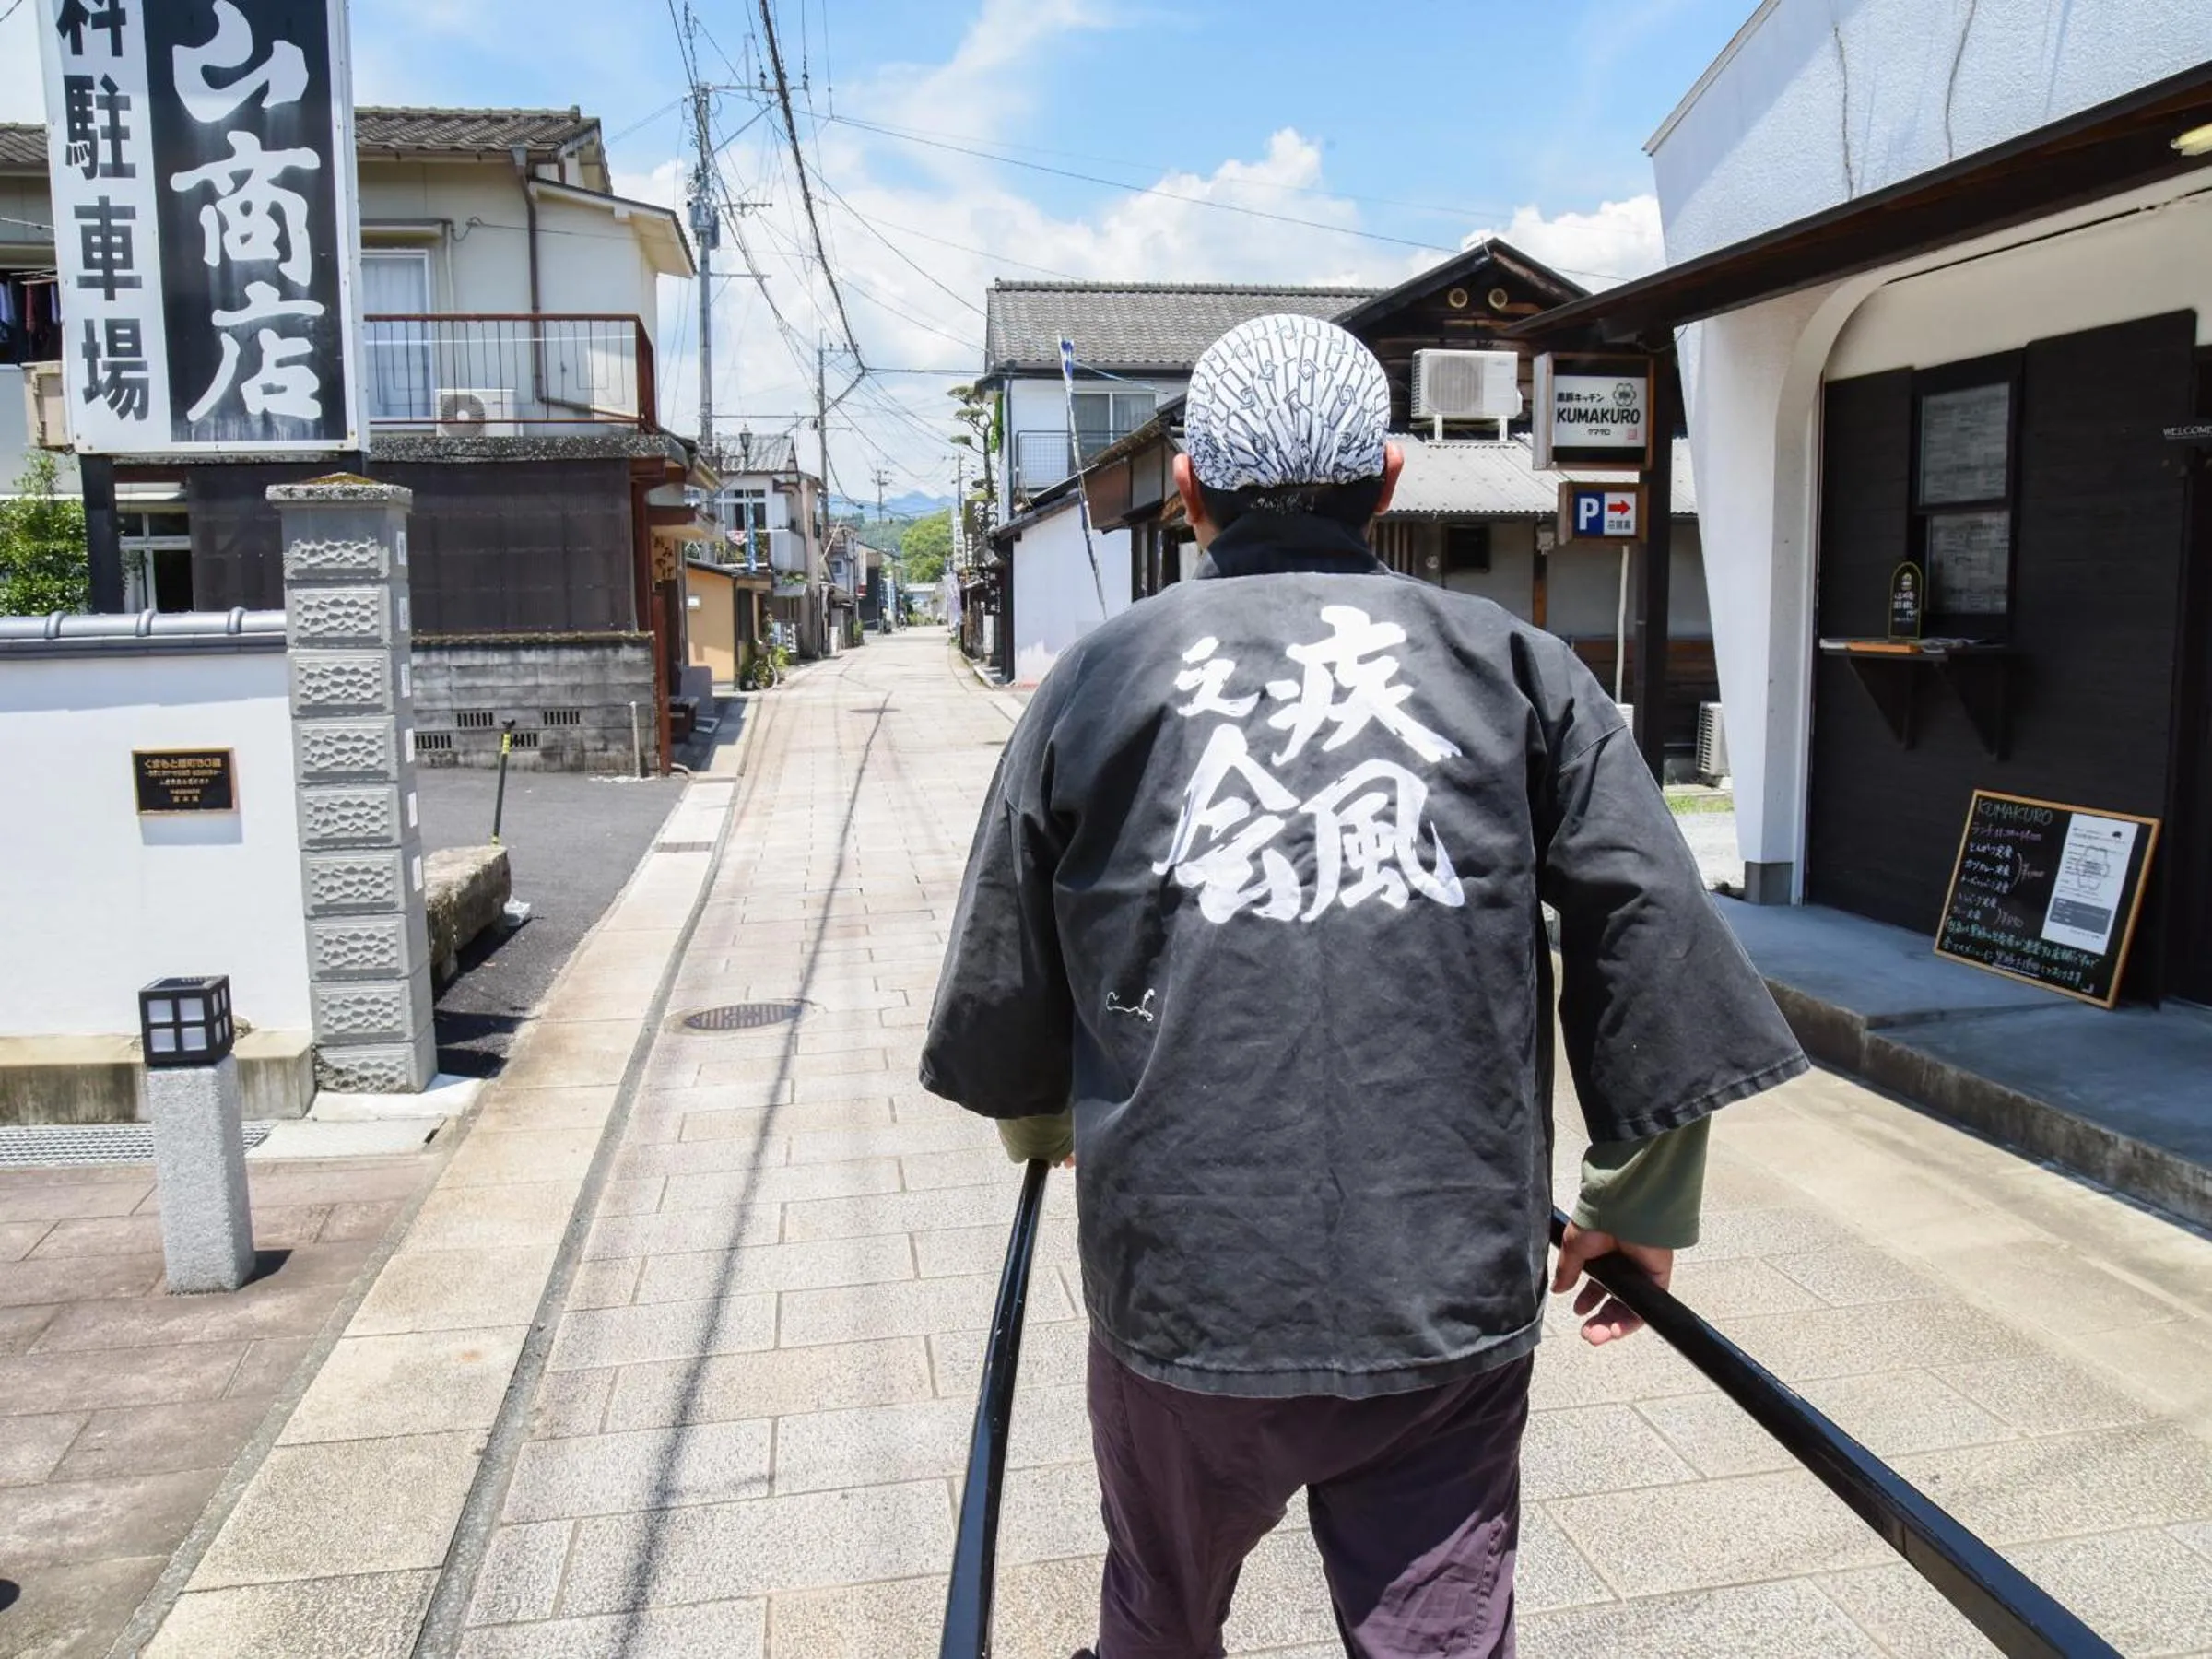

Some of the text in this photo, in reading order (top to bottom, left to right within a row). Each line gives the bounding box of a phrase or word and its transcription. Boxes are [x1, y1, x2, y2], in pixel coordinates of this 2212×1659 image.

[170, 0, 326, 423] 山商店
[1557, 407, 1641, 425] KUMAKURO
[1579, 498, 1600, 531] P
[1978, 798, 2053, 826] KUMAKURO
